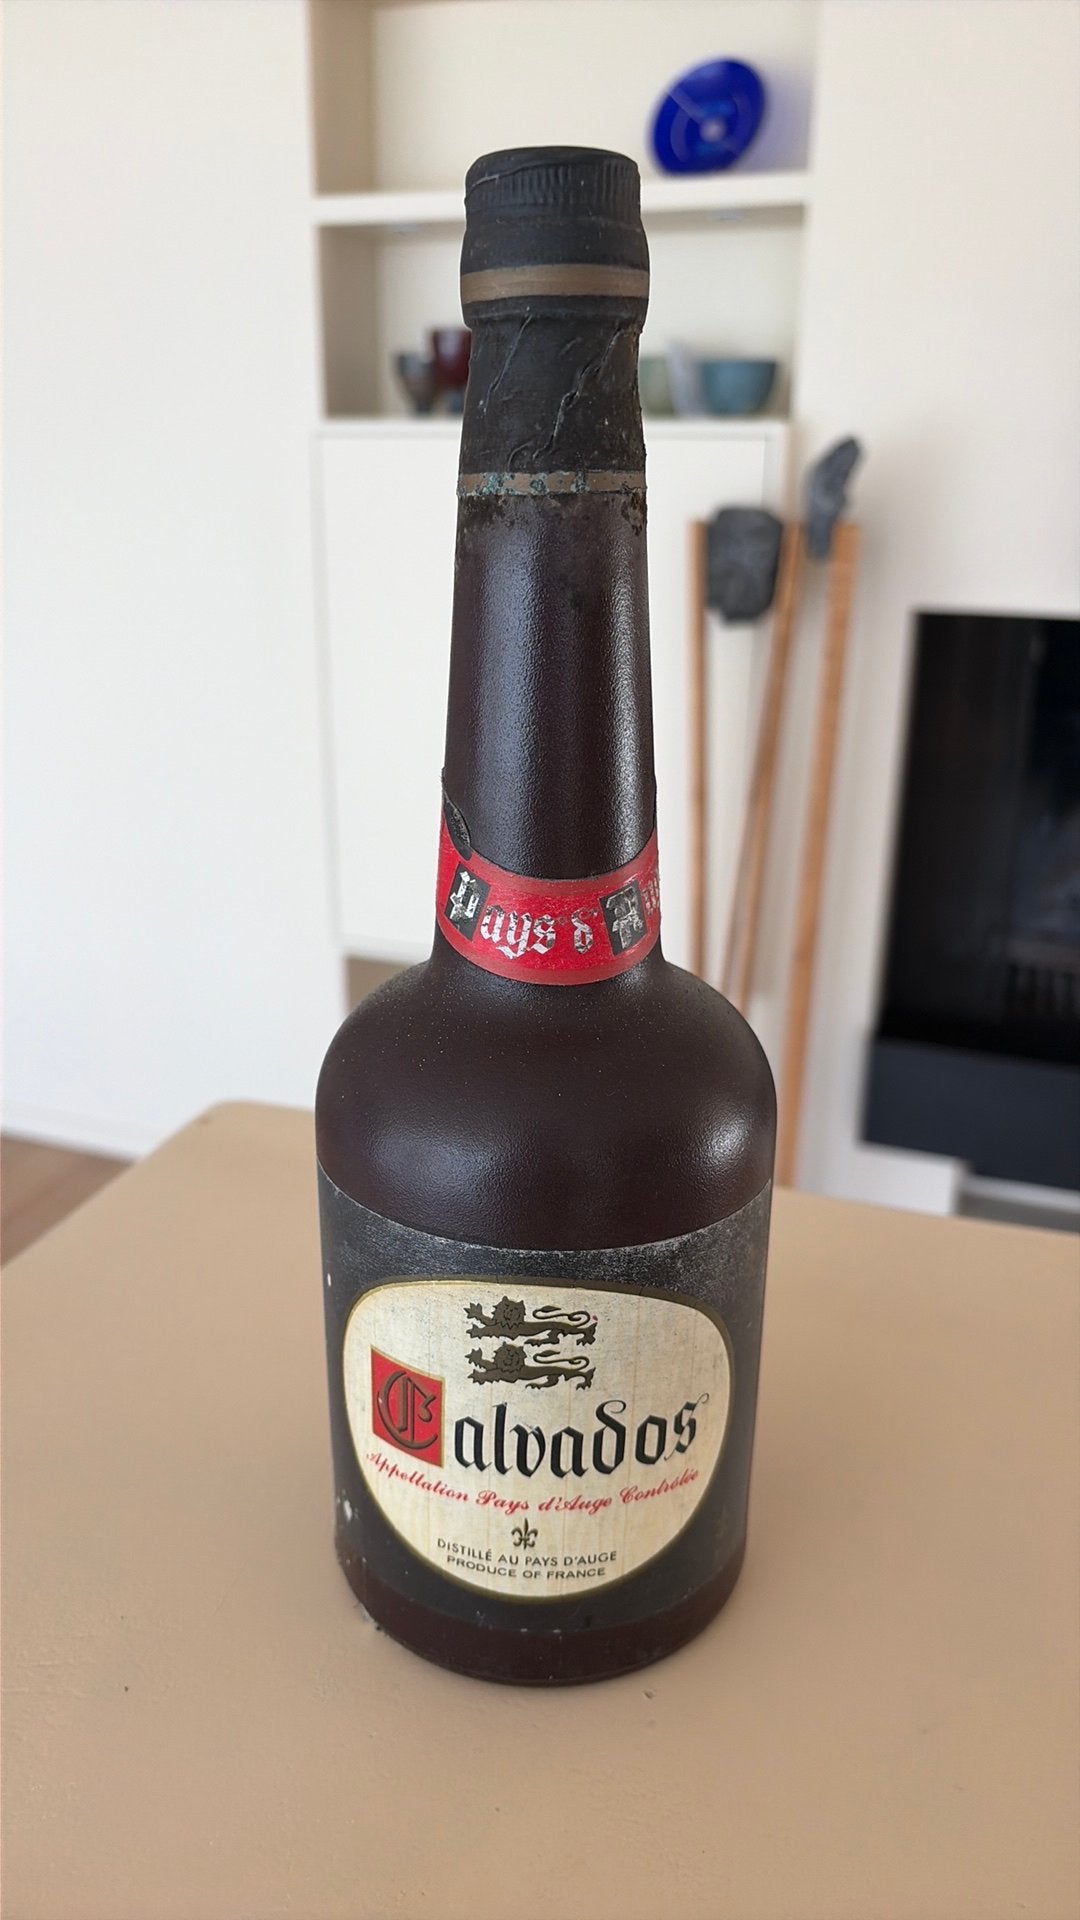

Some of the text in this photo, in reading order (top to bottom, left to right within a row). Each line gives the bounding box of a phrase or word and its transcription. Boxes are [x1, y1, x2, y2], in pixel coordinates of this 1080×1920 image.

[377, 1370, 710, 1479] Calvados
[366, 1452, 699, 1516] Appellation Pays d'Auge Contrôlée
[437, 1538, 617, 1567] DISTILLÉ AU PAYS D'AUGE
[447, 1555, 606, 1580] PRODUCE OF FRANCE
